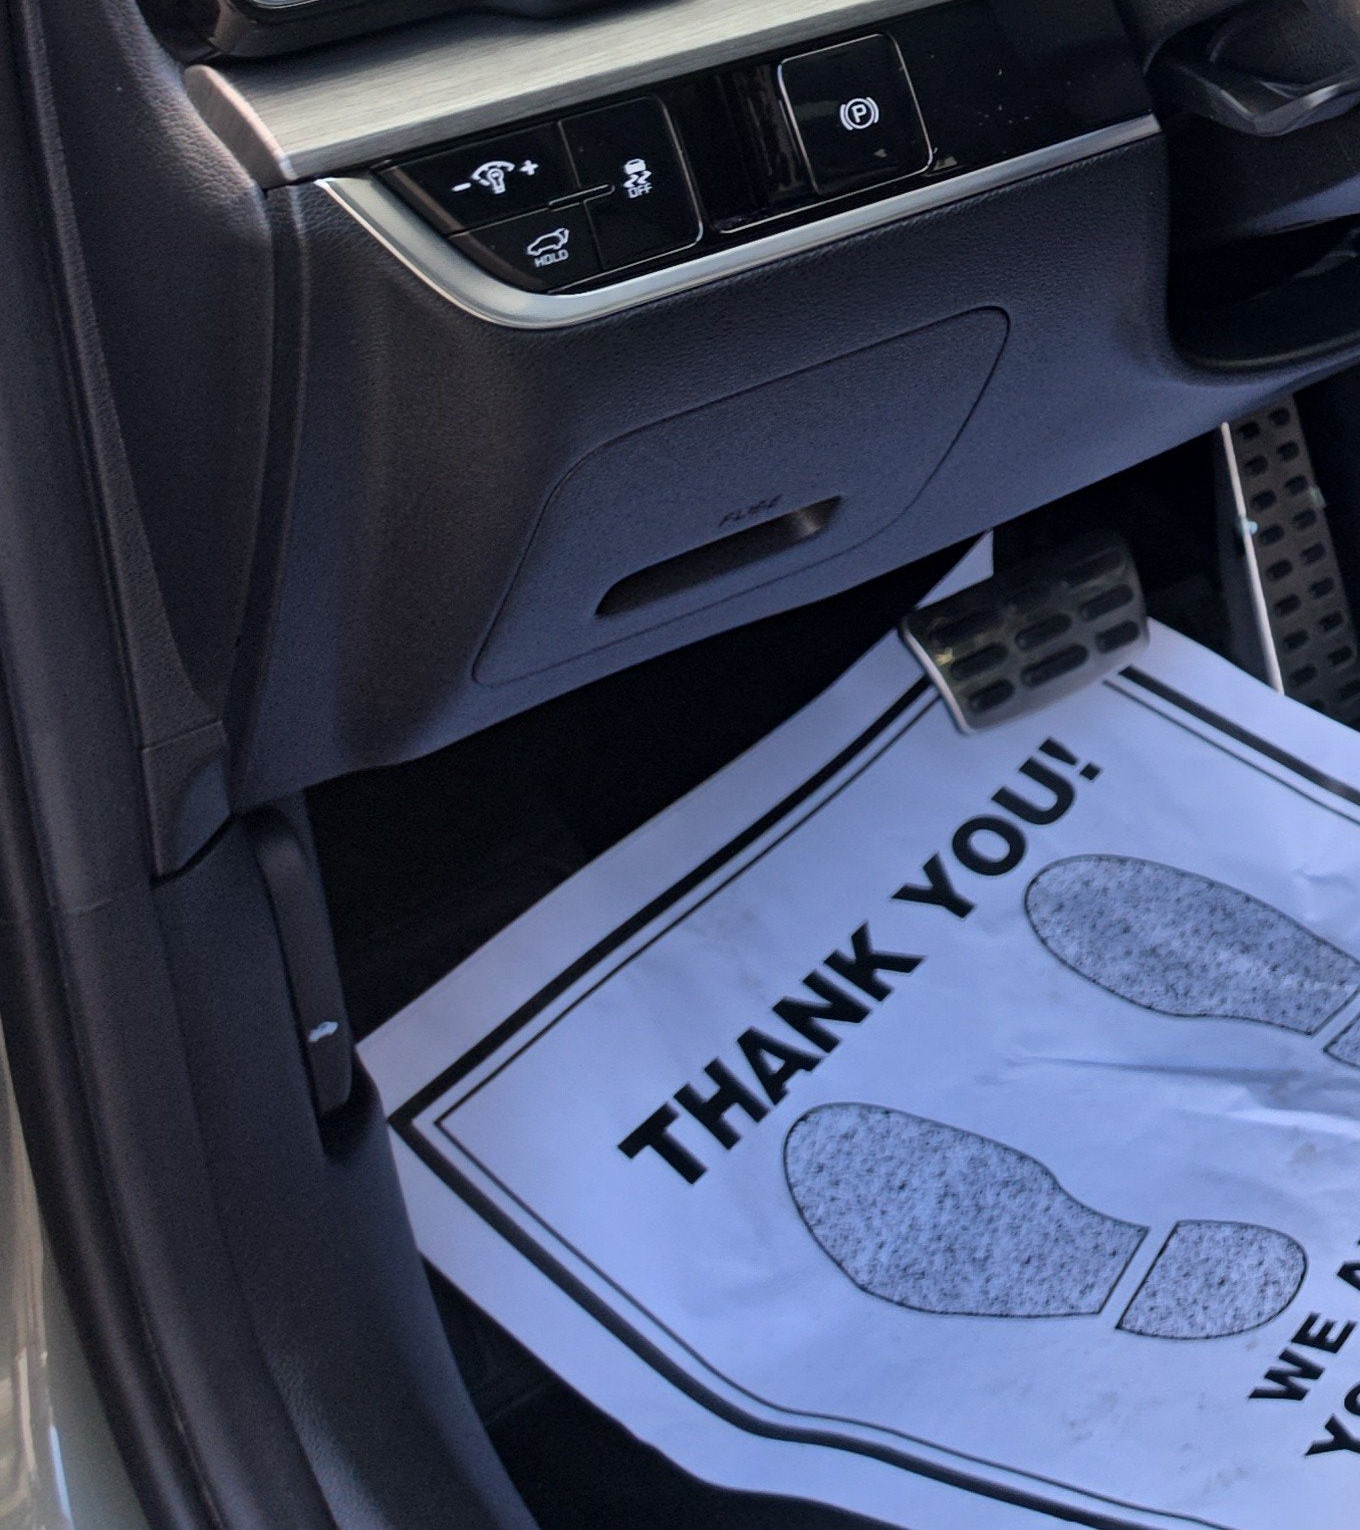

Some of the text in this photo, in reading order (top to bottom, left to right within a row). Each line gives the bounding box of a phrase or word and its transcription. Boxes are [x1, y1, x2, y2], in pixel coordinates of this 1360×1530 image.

[627, 183, 653, 200] OFF
[534, 249, 569, 268] HOLD
[616, 737, 1103, 1186] THANK YOU!
[1248, 1311, 1358, 1403] WE
